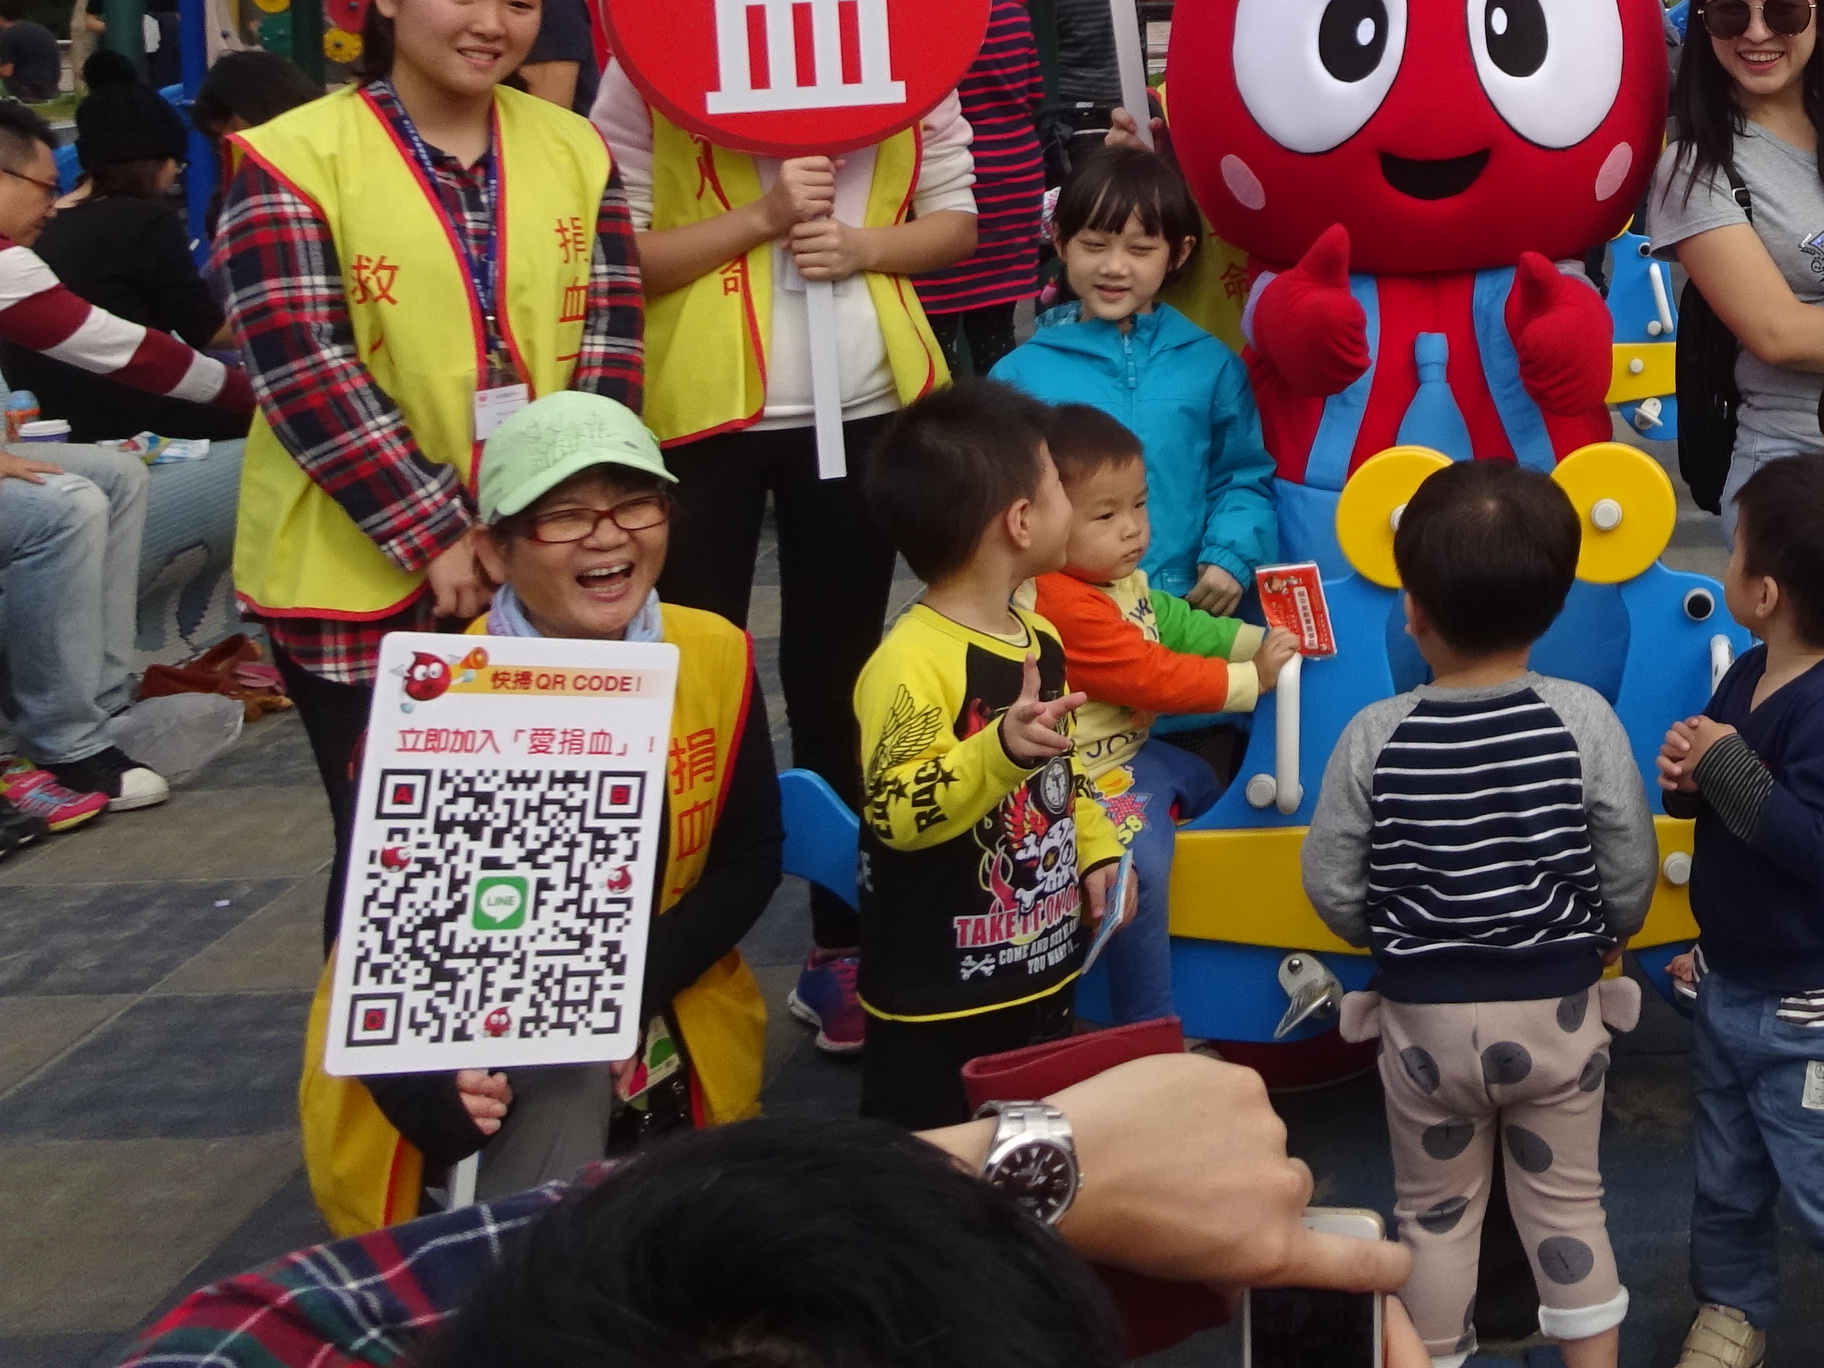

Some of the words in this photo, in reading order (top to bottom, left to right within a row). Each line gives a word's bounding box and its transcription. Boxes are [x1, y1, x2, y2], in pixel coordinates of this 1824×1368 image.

[490, 670, 566, 692] 快掃QR
[572, 674, 642, 693] CODE!
[486, 895, 517, 907] LINE
[954, 911, 1017, 948] TAKE
[1020, 899, 1044, 936] IT
[999, 944, 1029, 965] COME
[1030, 936, 1049, 956] AND
[1027, 954, 1046, 974] YOU
